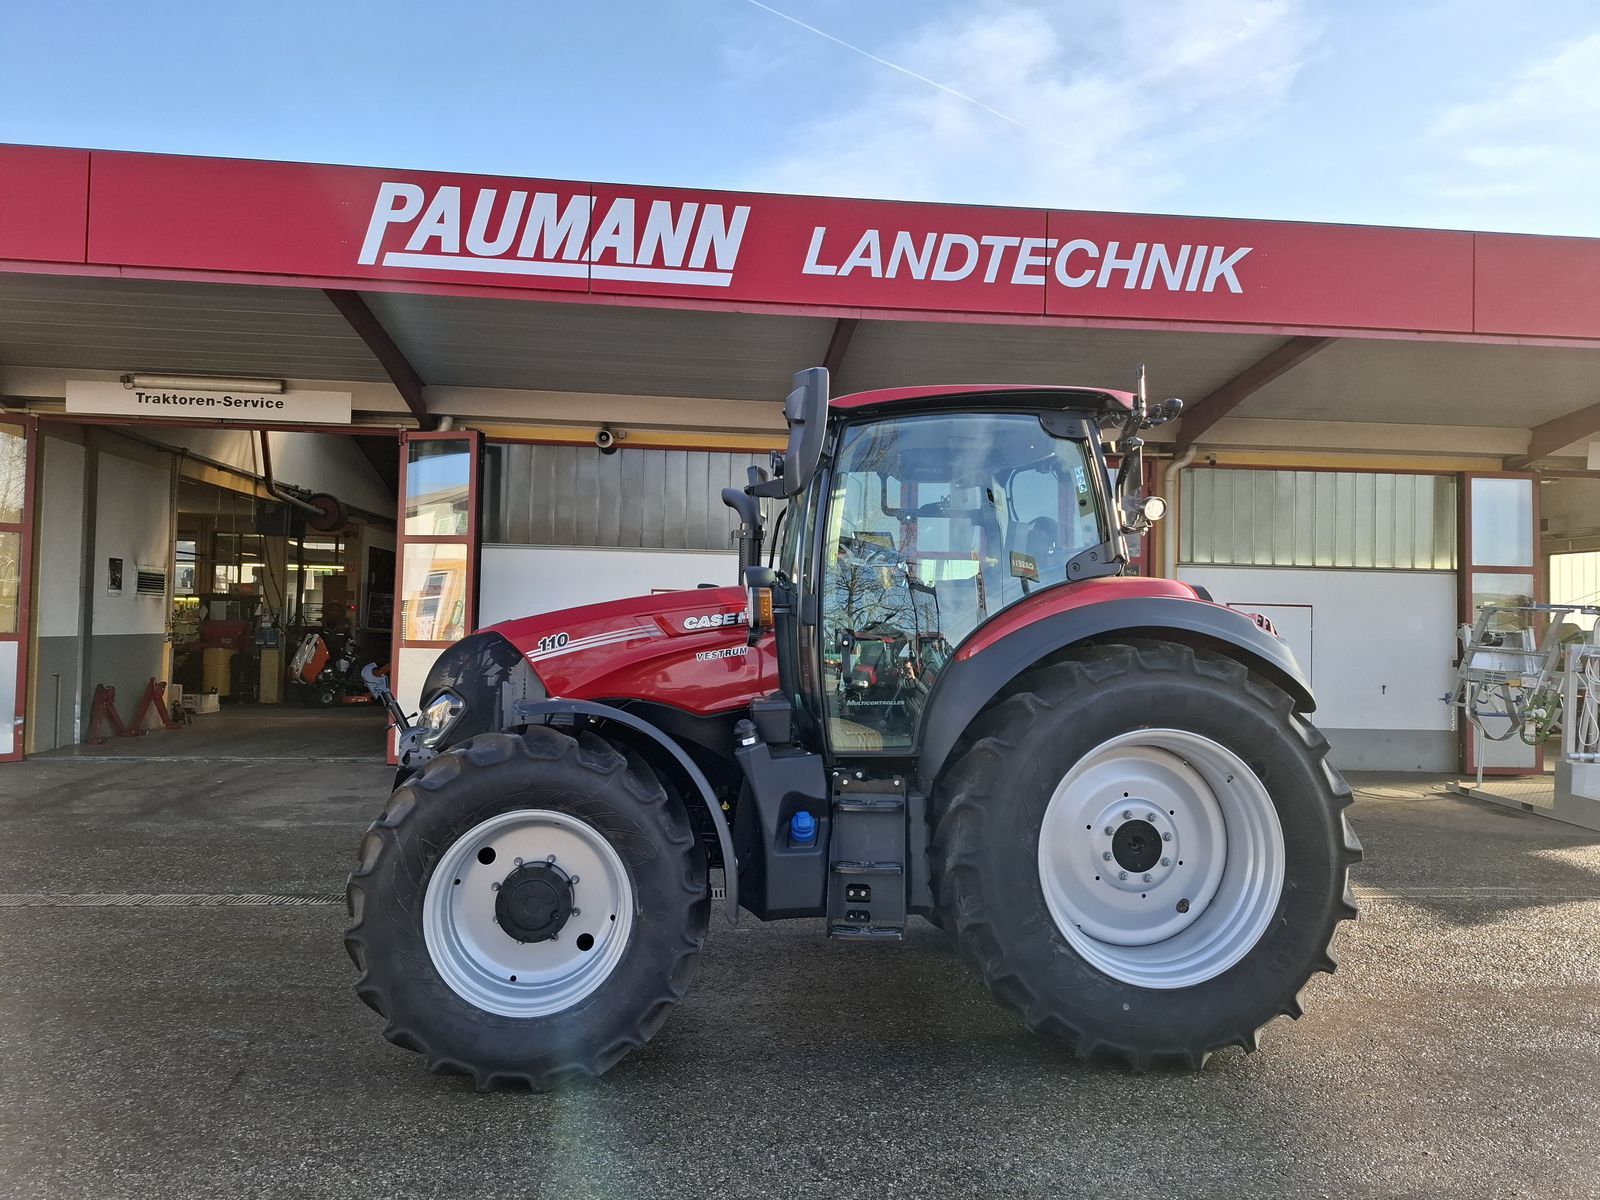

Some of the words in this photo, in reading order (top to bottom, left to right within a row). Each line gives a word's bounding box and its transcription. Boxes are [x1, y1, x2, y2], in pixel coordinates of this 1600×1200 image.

[357, 181, 751, 271] PAUMANN
[802, 226, 1253, 293] LANDTECHNIK
[135, 392, 284, 409] Traktoren-Service
[683, 612, 737, 630] CASE
[538, 632, 569, 652] 110
[696, 646, 748, 661] VESTRUM
